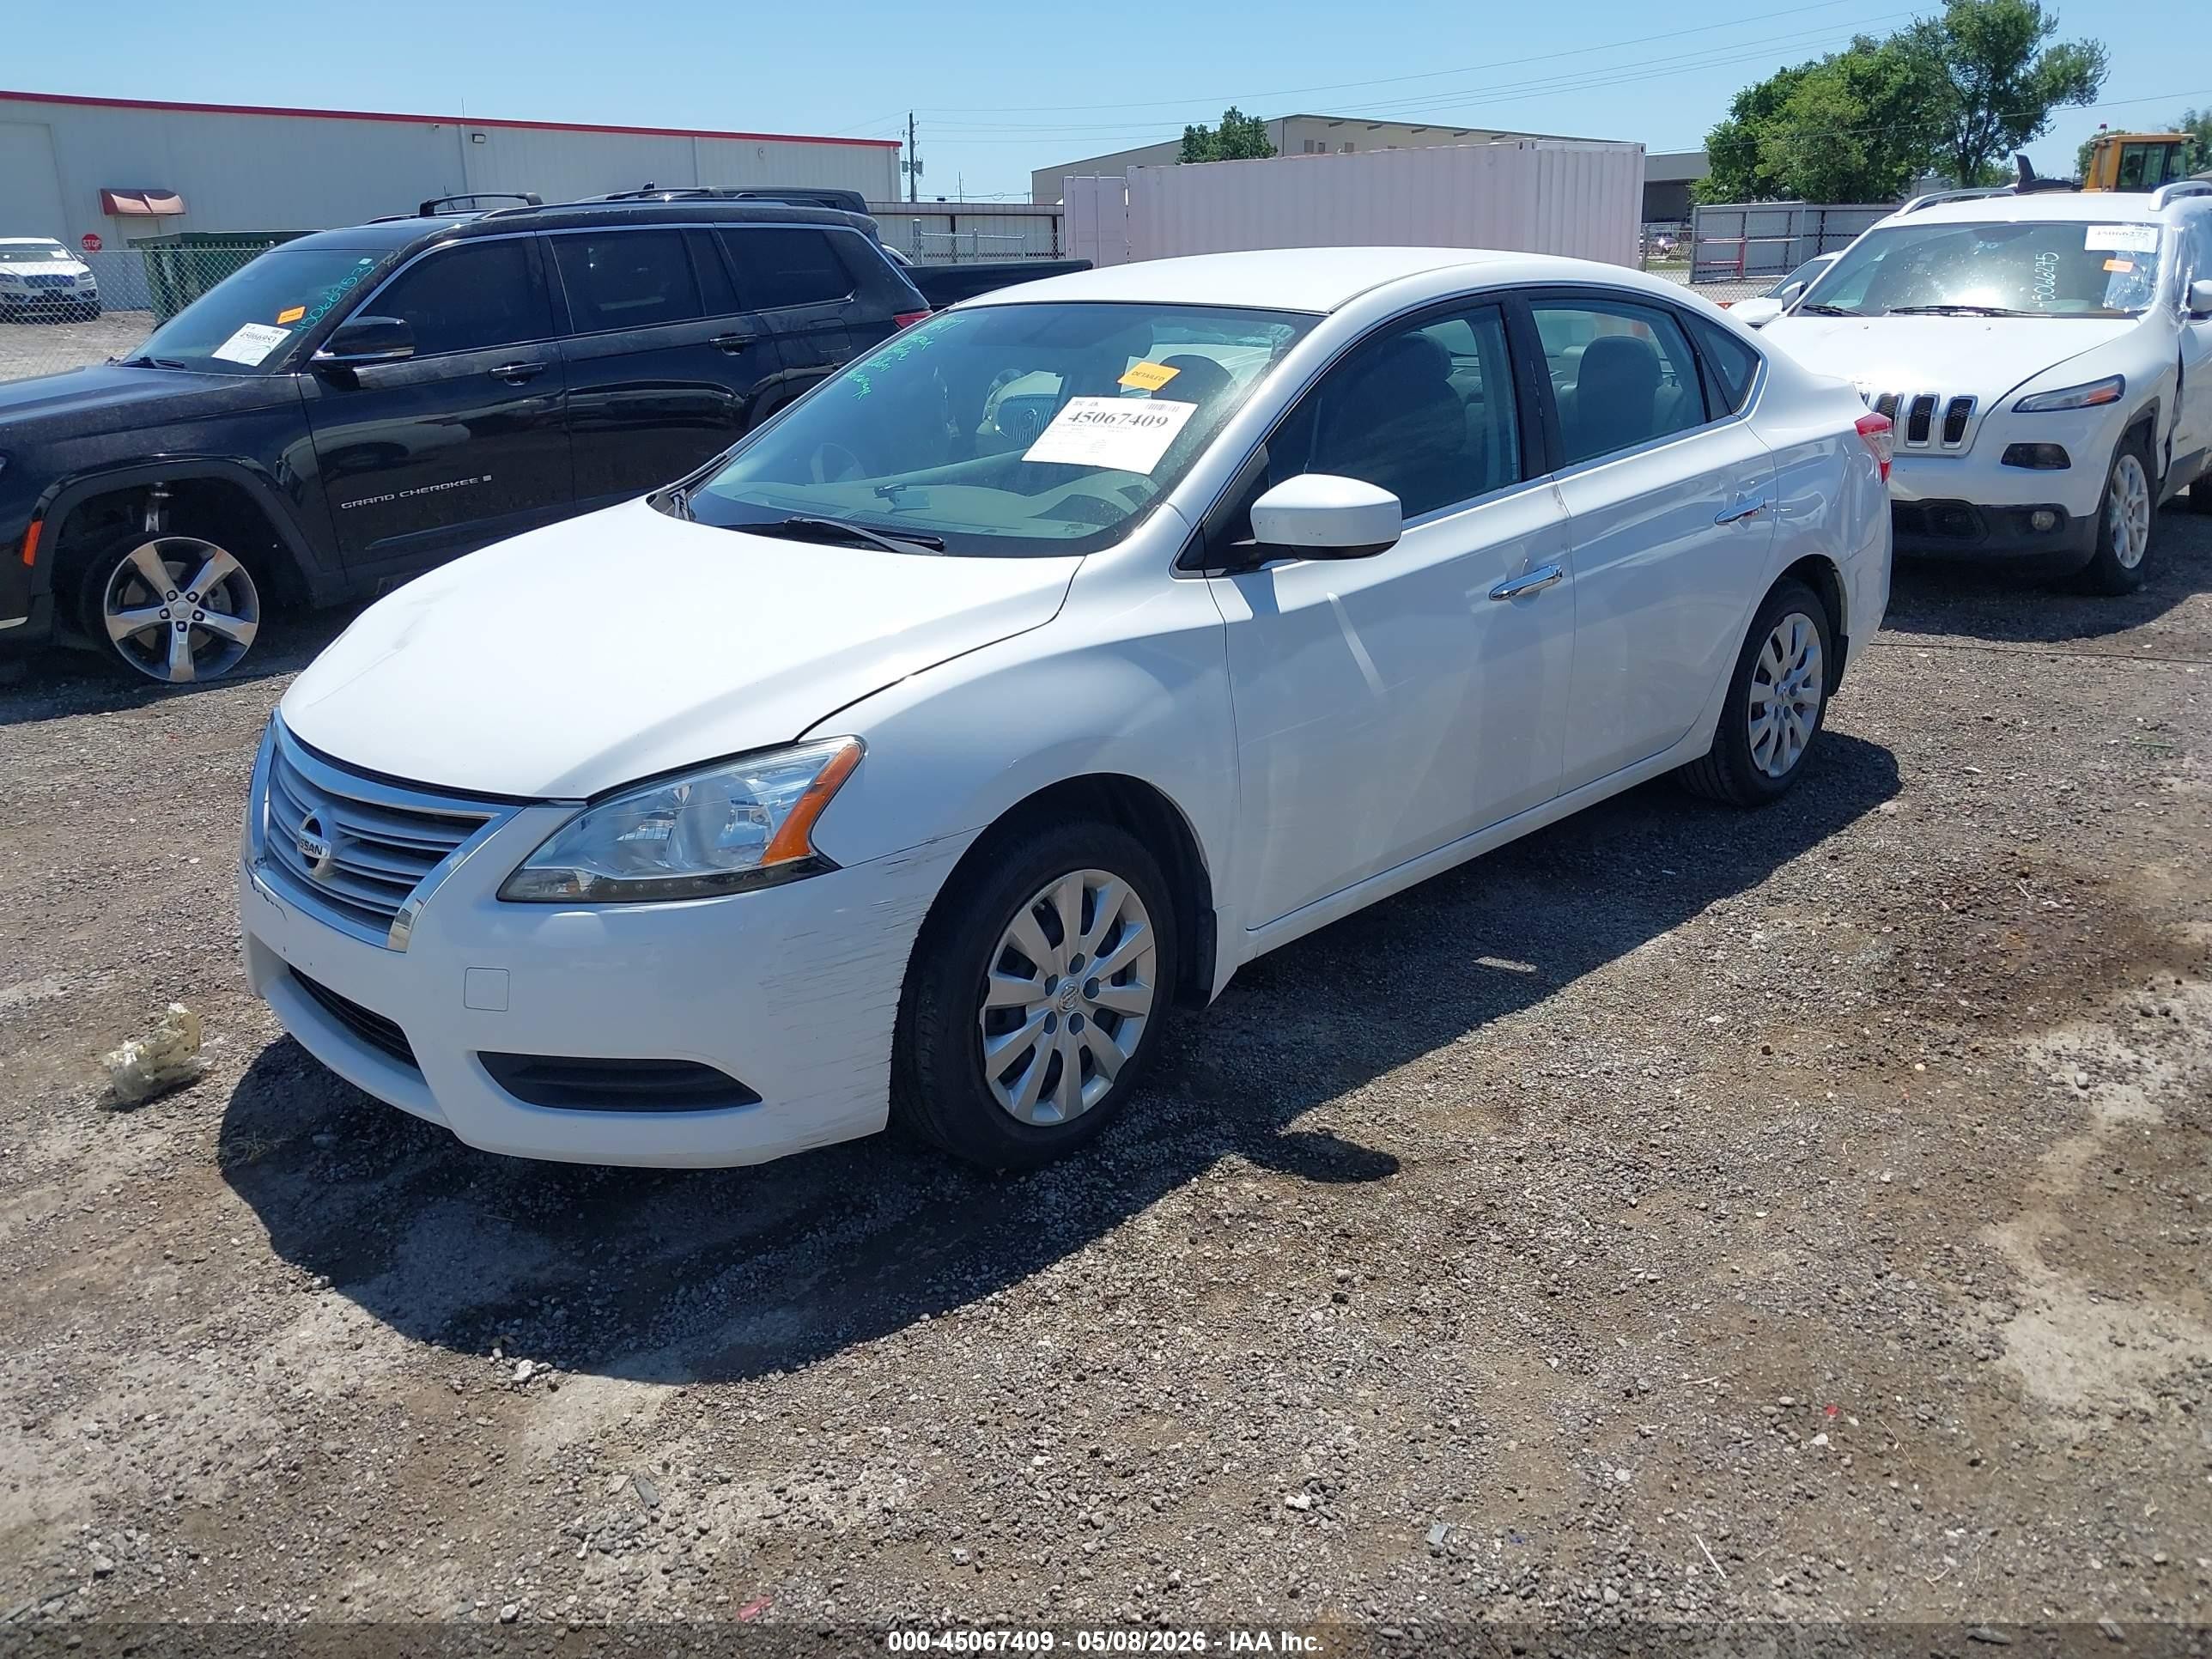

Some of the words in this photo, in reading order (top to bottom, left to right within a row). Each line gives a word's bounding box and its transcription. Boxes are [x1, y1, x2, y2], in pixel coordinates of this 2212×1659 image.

[1067, 411, 1169, 428] 45067409
[341, 494, 395, 509] GRAND
[399, 477, 479, 498] CHEROKEE
